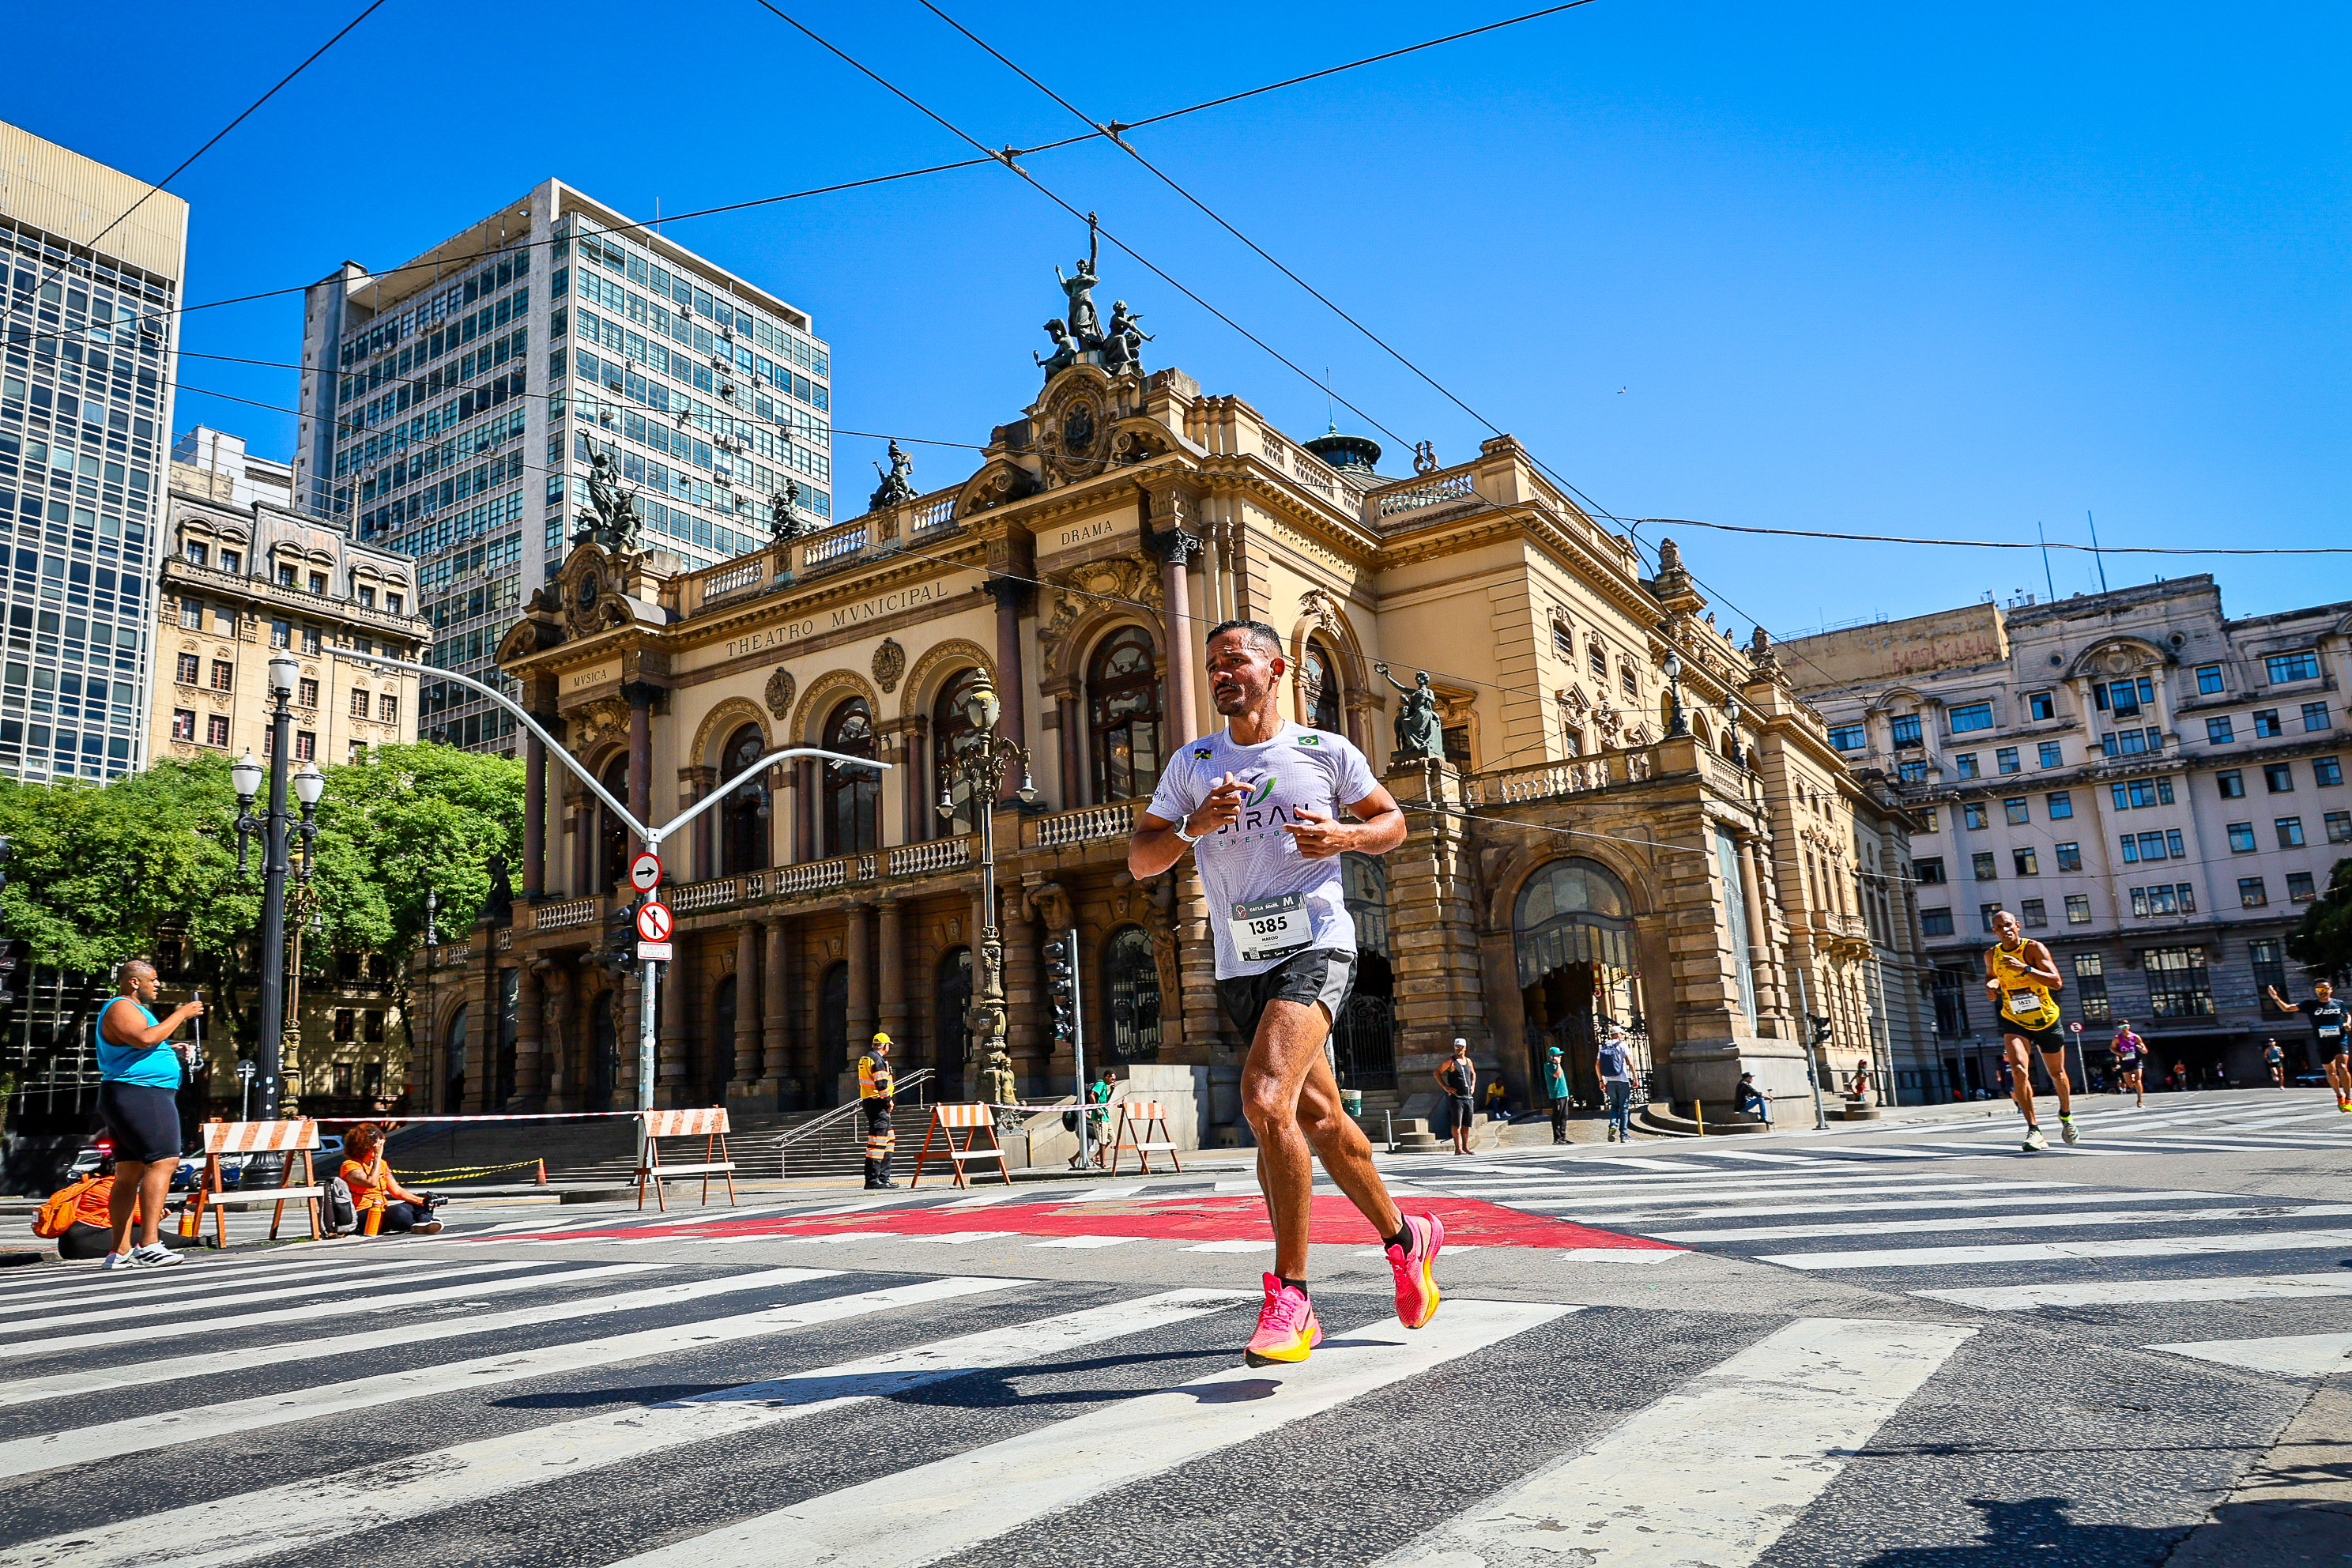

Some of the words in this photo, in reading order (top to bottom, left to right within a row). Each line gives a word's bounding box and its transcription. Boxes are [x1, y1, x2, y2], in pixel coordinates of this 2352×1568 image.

[1061, 520, 1113, 545] DRAMA
[726, 620, 813, 657] THEATRO
[831, 581, 948, 628] MVNICIPAL
[574, 669, 607, 688] MVSICA
[1219, 830, 1280, 847] ENERG
[1249, 916, 1287, 935] 1385
